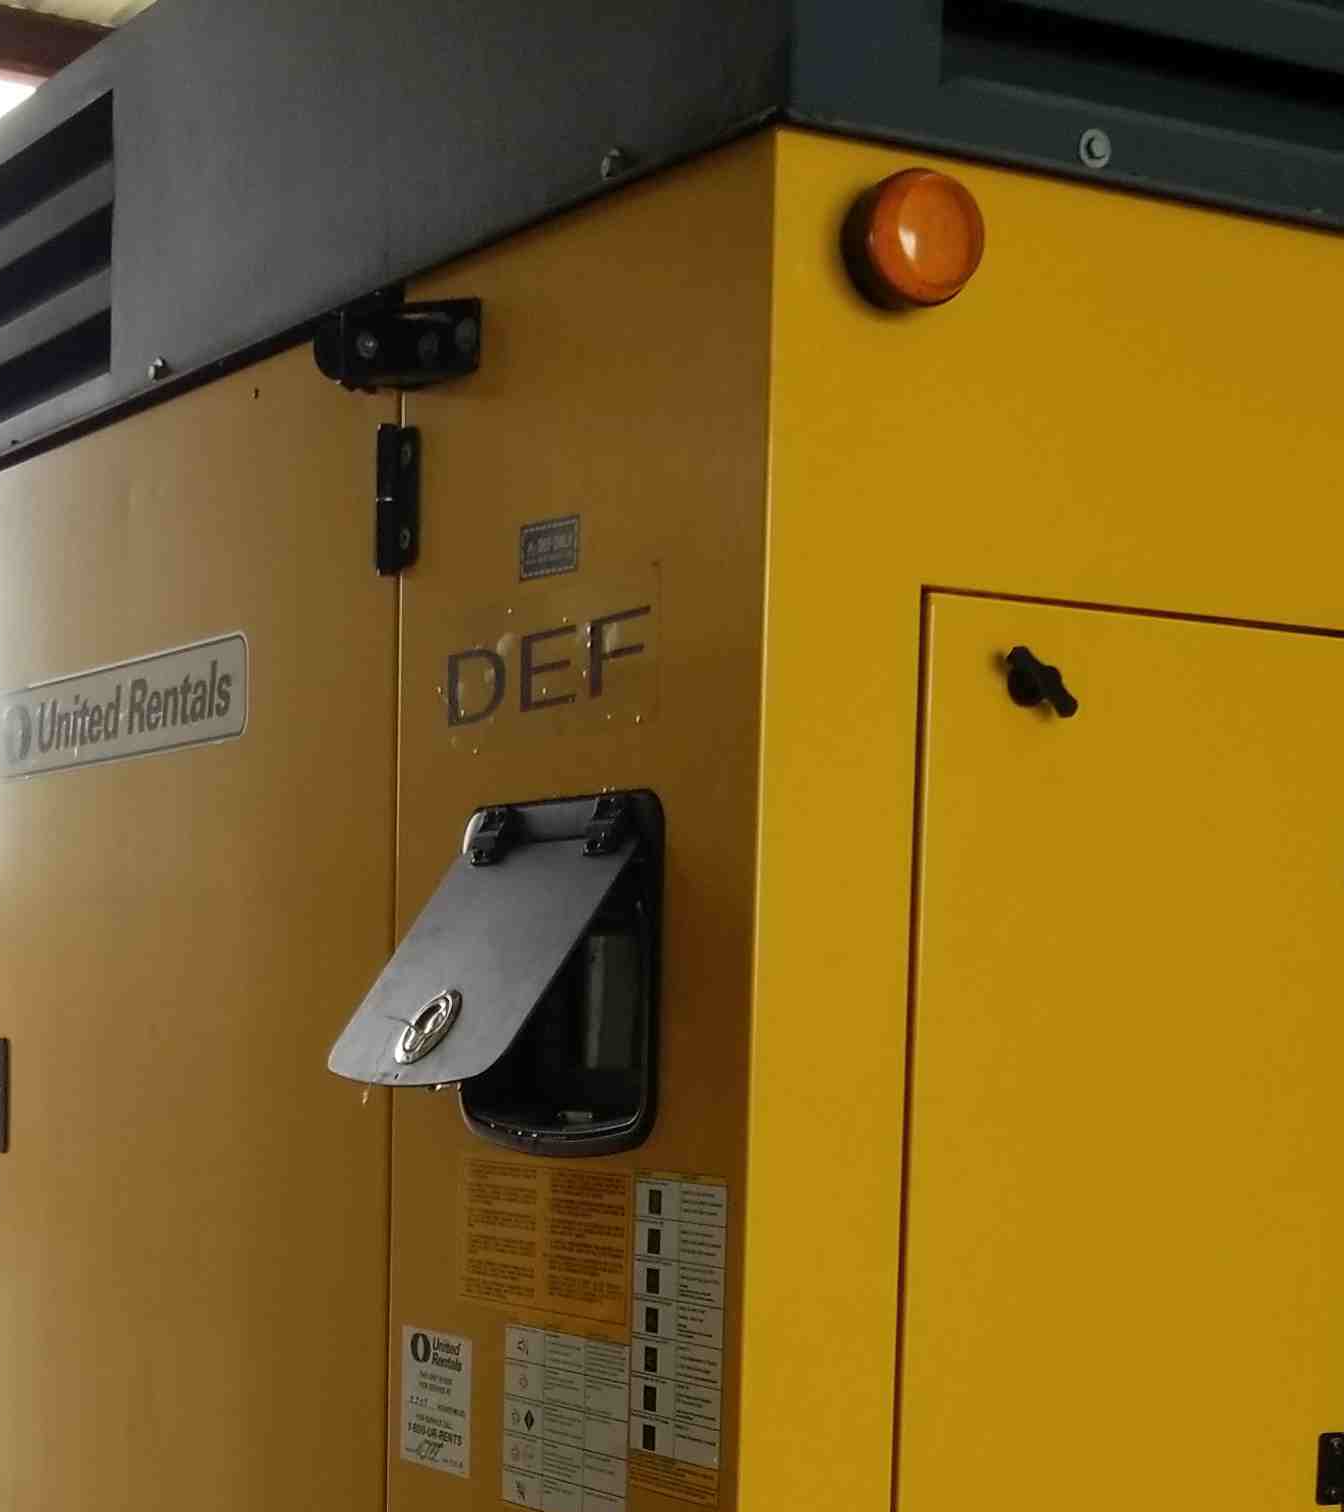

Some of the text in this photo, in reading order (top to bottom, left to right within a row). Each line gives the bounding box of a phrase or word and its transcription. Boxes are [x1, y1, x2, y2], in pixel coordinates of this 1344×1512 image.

[36, 659, 233, 754] United Rentals
[447, 604, 652, 729] DEF
